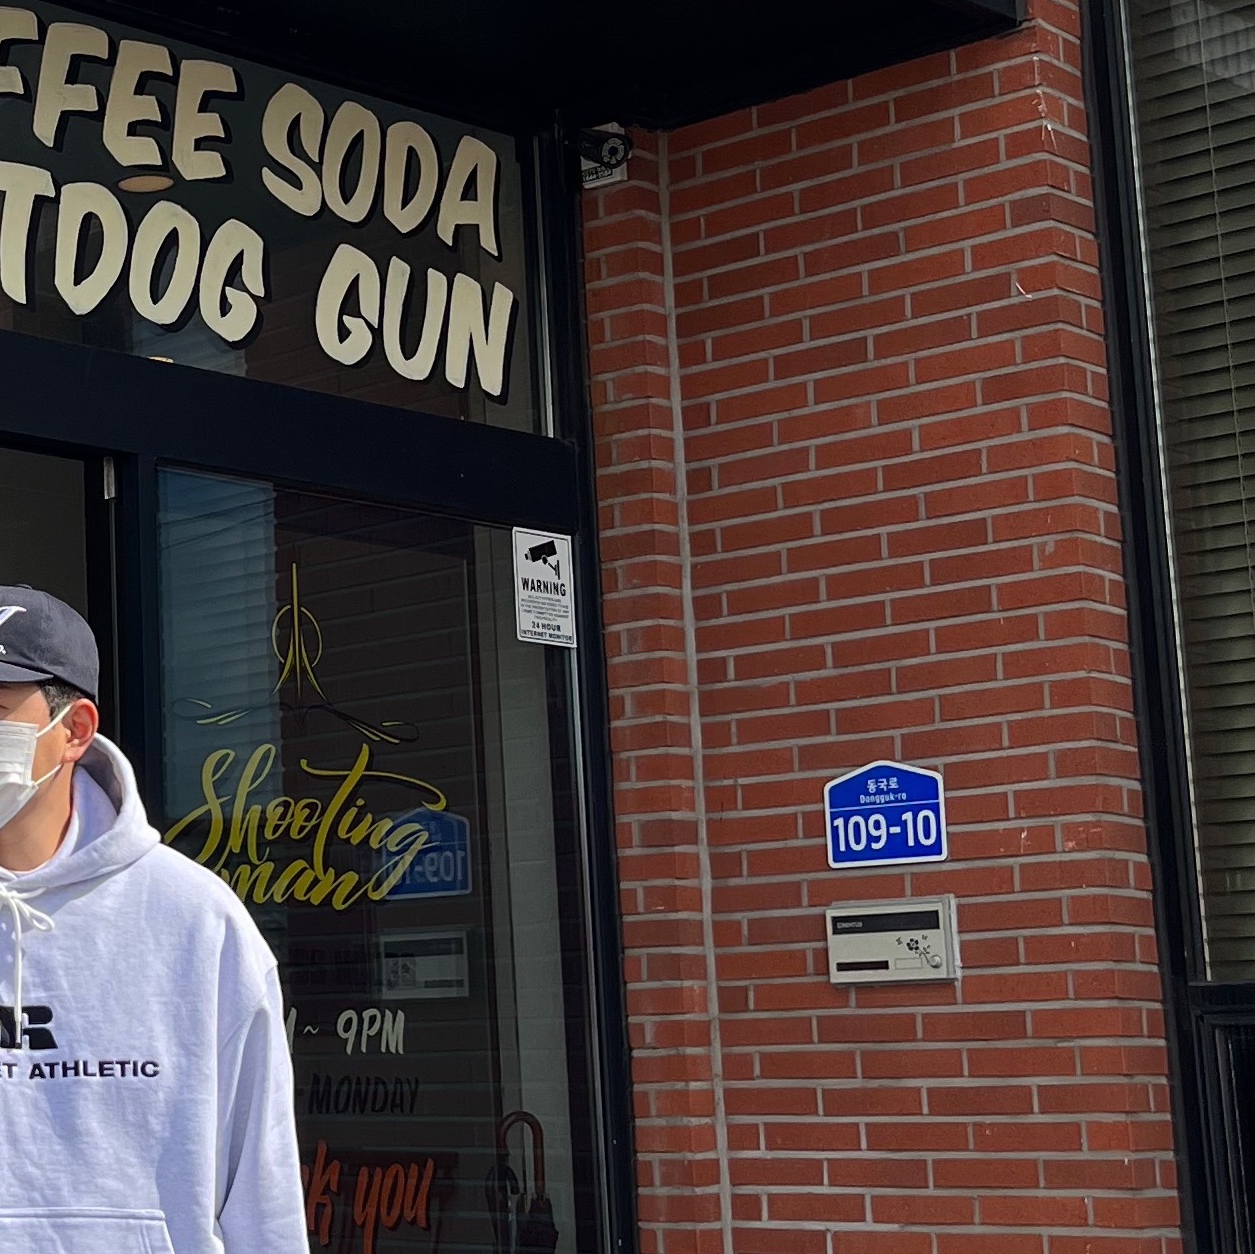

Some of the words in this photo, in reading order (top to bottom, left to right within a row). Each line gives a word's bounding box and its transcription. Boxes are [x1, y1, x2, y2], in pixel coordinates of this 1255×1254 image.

[261, 82, 499, 259] SODA
[315, 243, 513, 396] GUN
[521, 577, 566, 597] WARNING
[531, 621, 540, 630] 24
[541, 622, 561, 633] HOUR
[859, 791, 907, 804] Dongguk-ro
[866, 777, 899, 792] 동국로
[165, 743, 446, 900] Shooting
[833, 809, 937, 852] 109-10
[336, 1008, 405, 1055] 9PM
[28, 1060, 161, 1080] ATHLETIC
[308, 1072, 420, 1115] MONDAY
